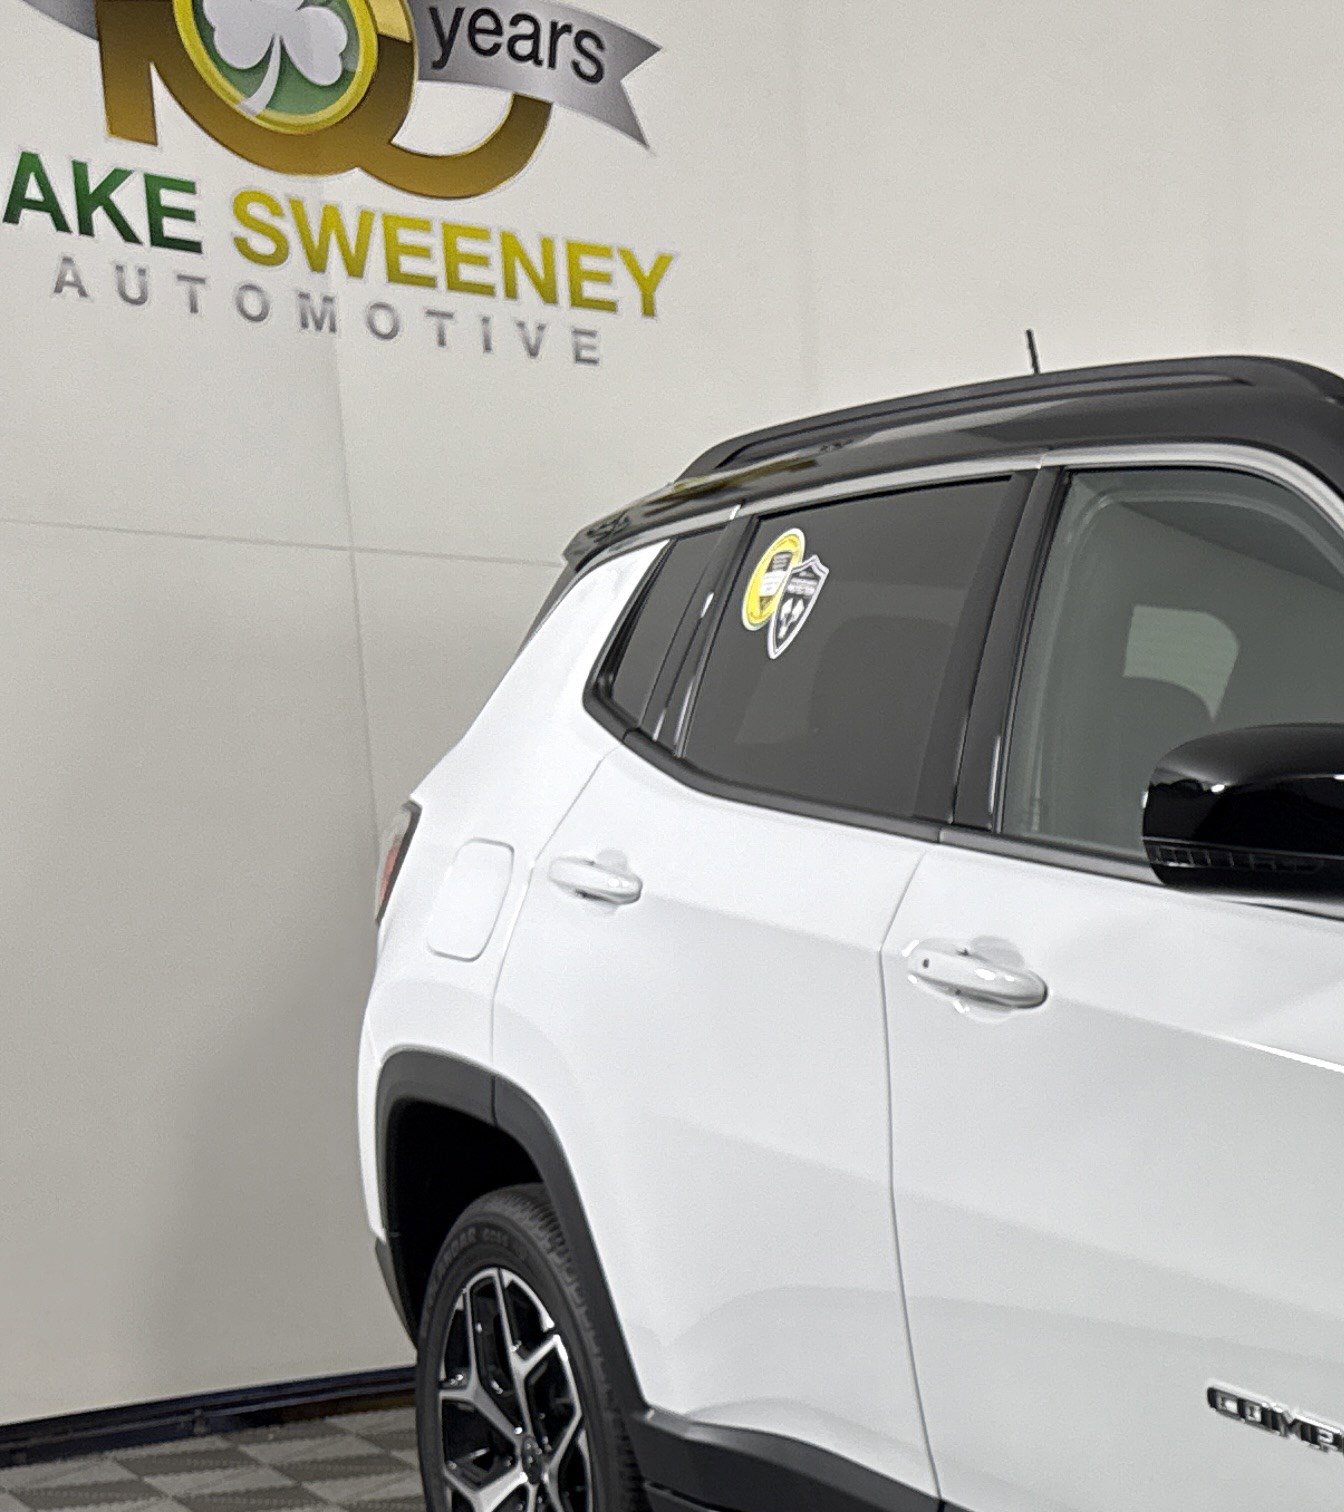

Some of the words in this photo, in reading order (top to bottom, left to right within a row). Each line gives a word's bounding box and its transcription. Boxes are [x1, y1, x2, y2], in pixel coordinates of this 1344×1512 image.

[429, 3, 608, 84] years
[2, 150, 203, 256] AKE
[232, 189, 673, 318] SWEENEY
[53, 254, 601, 367] AUTOMOTIVE
